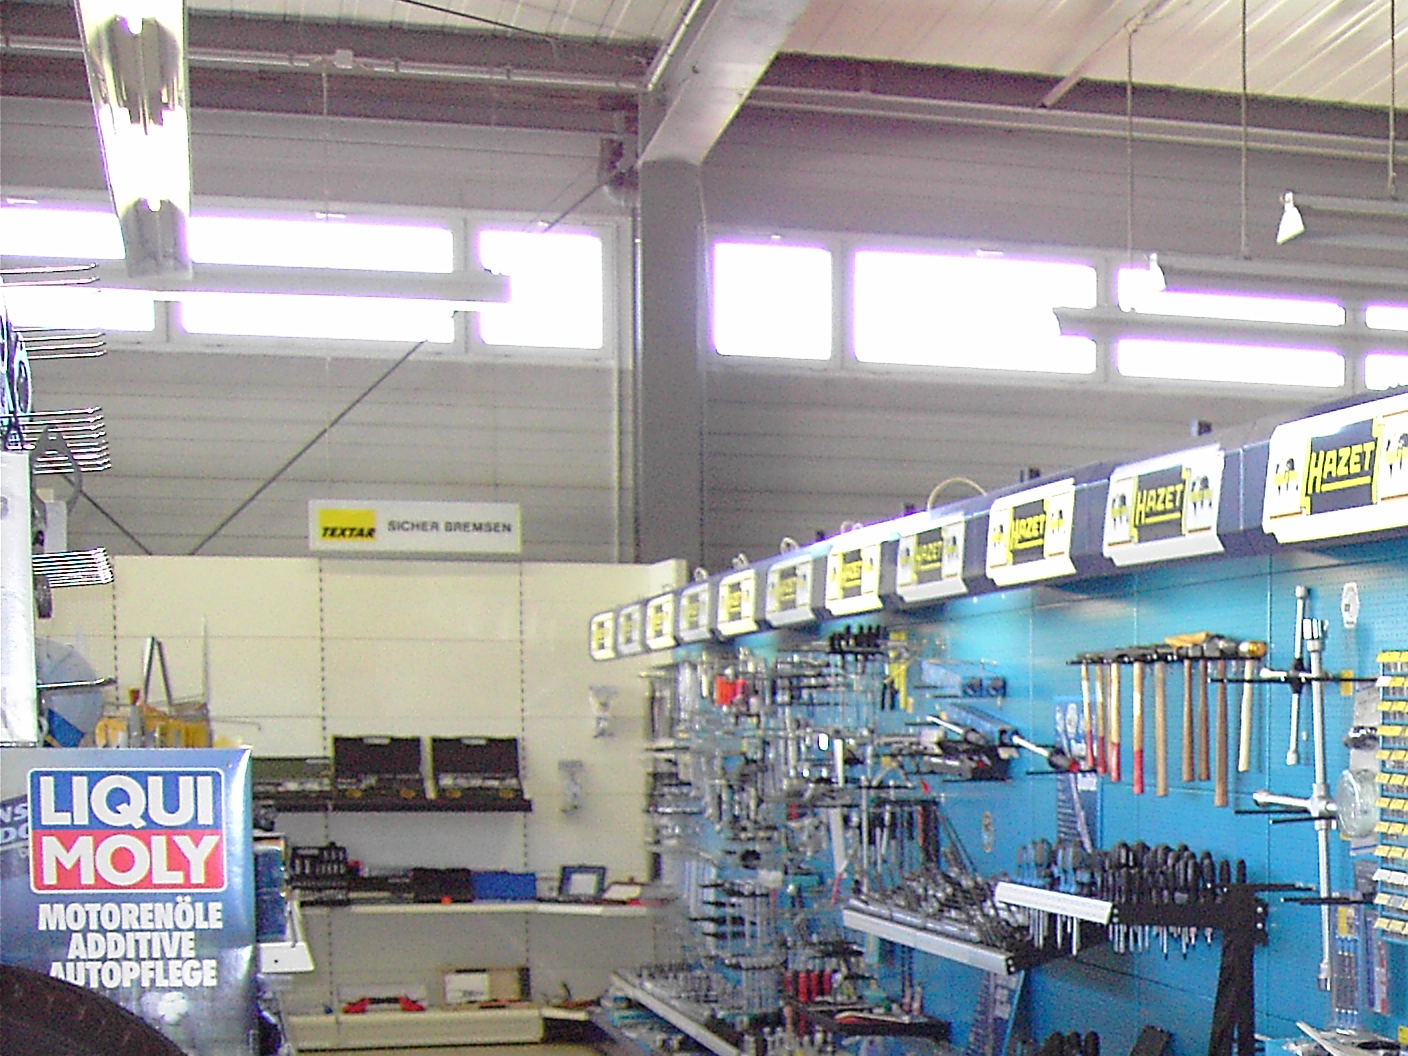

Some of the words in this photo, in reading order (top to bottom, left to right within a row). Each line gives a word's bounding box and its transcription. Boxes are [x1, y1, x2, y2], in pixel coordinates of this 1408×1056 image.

[1307, 441, 1376, 494] HAZET
[1135, 483, 1185, 526] HAZET
[321, 526, 376, 539] TEXTAR
[387, 519, 440, 533] SICHER
[444, 520, 512, 534] BREMSEN
[40, 774, 214, 829] LIQUI
[43, 834, 221, 886] MOLY
[38, 896, 223, 931] MOTORENÖLE
[67, 931, 196, 960] ADDITIVE
[49, 959, 217, 989] AUTOPFLEGE
